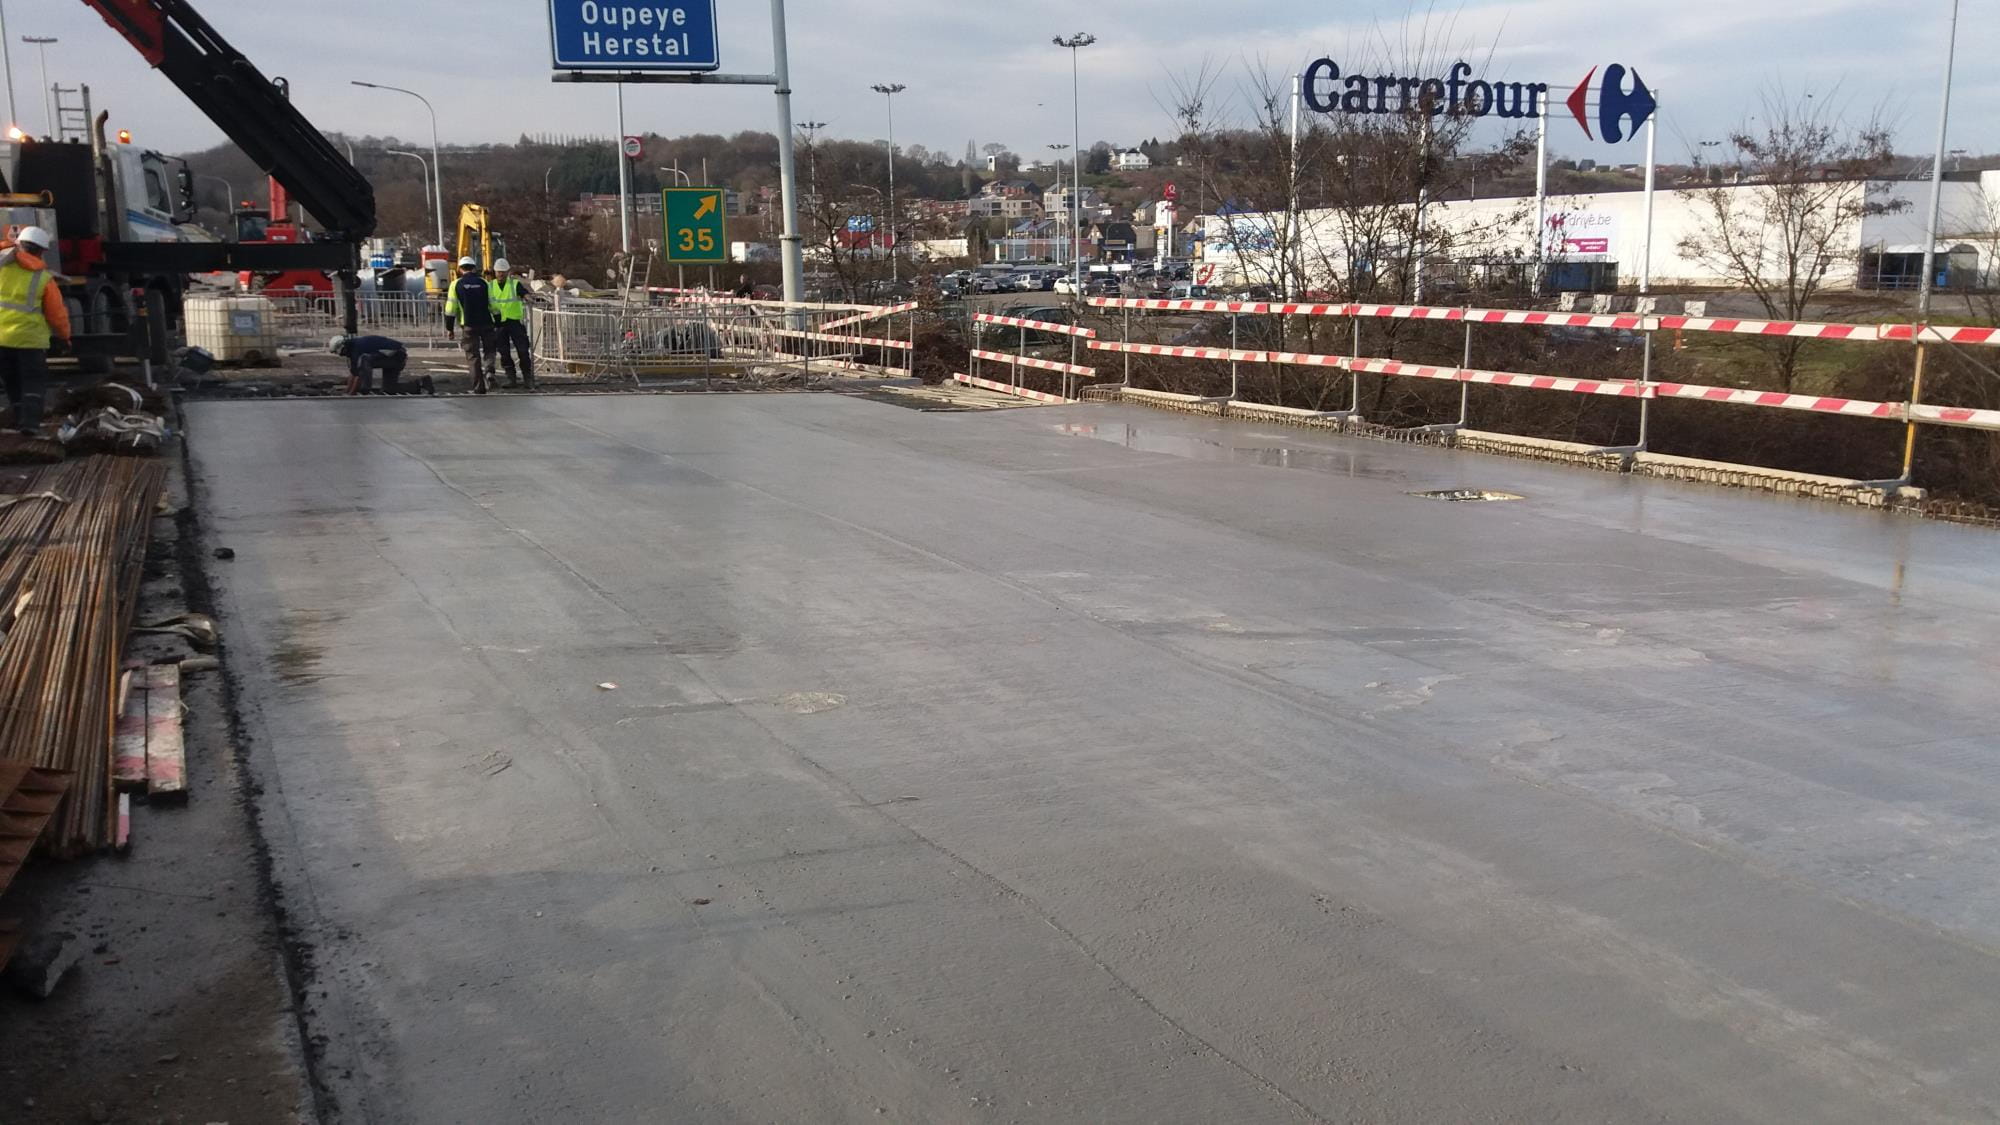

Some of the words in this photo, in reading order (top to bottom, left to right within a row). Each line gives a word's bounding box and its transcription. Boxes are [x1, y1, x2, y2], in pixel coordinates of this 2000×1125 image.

[581, 0, 686, 31] Oupeye
[583, 31, 689, 56] Herstal
[1303, 57, 1547, 119] Carrefour
[678, 228, 714, 251] 35
